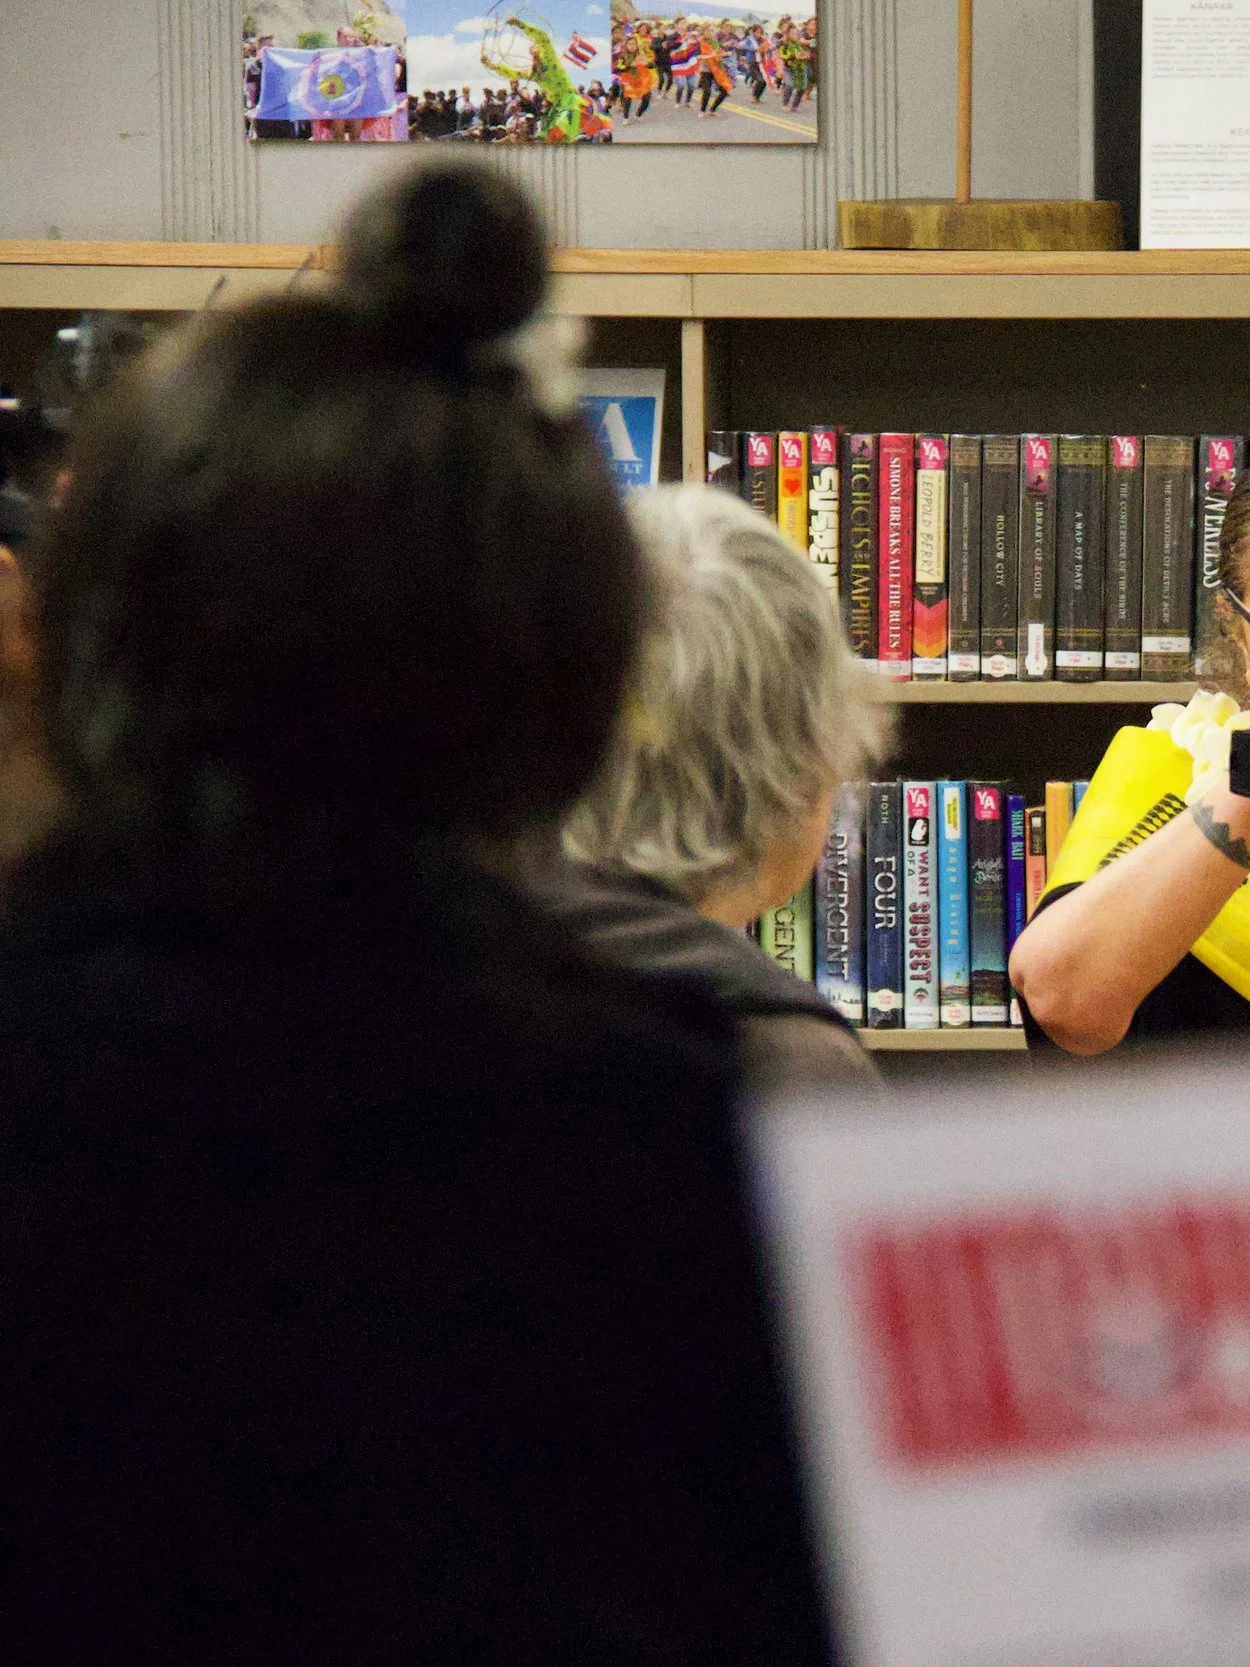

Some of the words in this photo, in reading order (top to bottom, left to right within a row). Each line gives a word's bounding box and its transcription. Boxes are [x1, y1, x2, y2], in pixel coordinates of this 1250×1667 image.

[749, 437, 769, 456] YA
[782, 440, 800, 459] YA
[813, 433, 832, 452] YA
[922, 441, 941, 460] YA
[1029, 440, 1047, 459] YA
[1115, 437, 1135, 457] YA
[1211, 441, 1230, 460] YA
[888, 457, 901, 502] SIMONE
[1119, 482, 1129, 498] THE
[920, 474, 934, 528] LEOPOLD
[888, 506, 901, 555] BREAKS
[1034, 501, 1044, 544] LIBRARY
[1074, 521, 1083, 543] MAP
[1118, 501, 1128, 558] CONFERENCE
[995, 515, 1005, 559] HOLLOW
[919, 532, 935, 577] BERRY
[1033, 548, 1043, 563] OF
[1073, 546, 1083, 562] OF
[888, 558, 900, 580] ALL
[995, 562, 1005, 587] CITY
[1073, 564, 1083, 591] DAYS
[1118, 561, 1128, 573] OF
[1033, 565, 1043, 599] SOULS
[888, 583, 900, 607] THE
[888, 610, 900, 648] RULES
[880, 794, 889, 825] ROTH
[908, 789, 928, 808] YA
[976, 790, 996, 810] YA
[1011, 809, 1024, 838] SHARK
[907, 851, 916, 866] OF
[1011, 841, 1024, 860] BAIT
[907, 868, 916, 877] A
[918, 850, 930, 897] WANT
[874, 855, 897, 929] FOUR
[826, 832, 849, 981] DIVERGENT
[908, 901, 932, 985] SUSPECT
